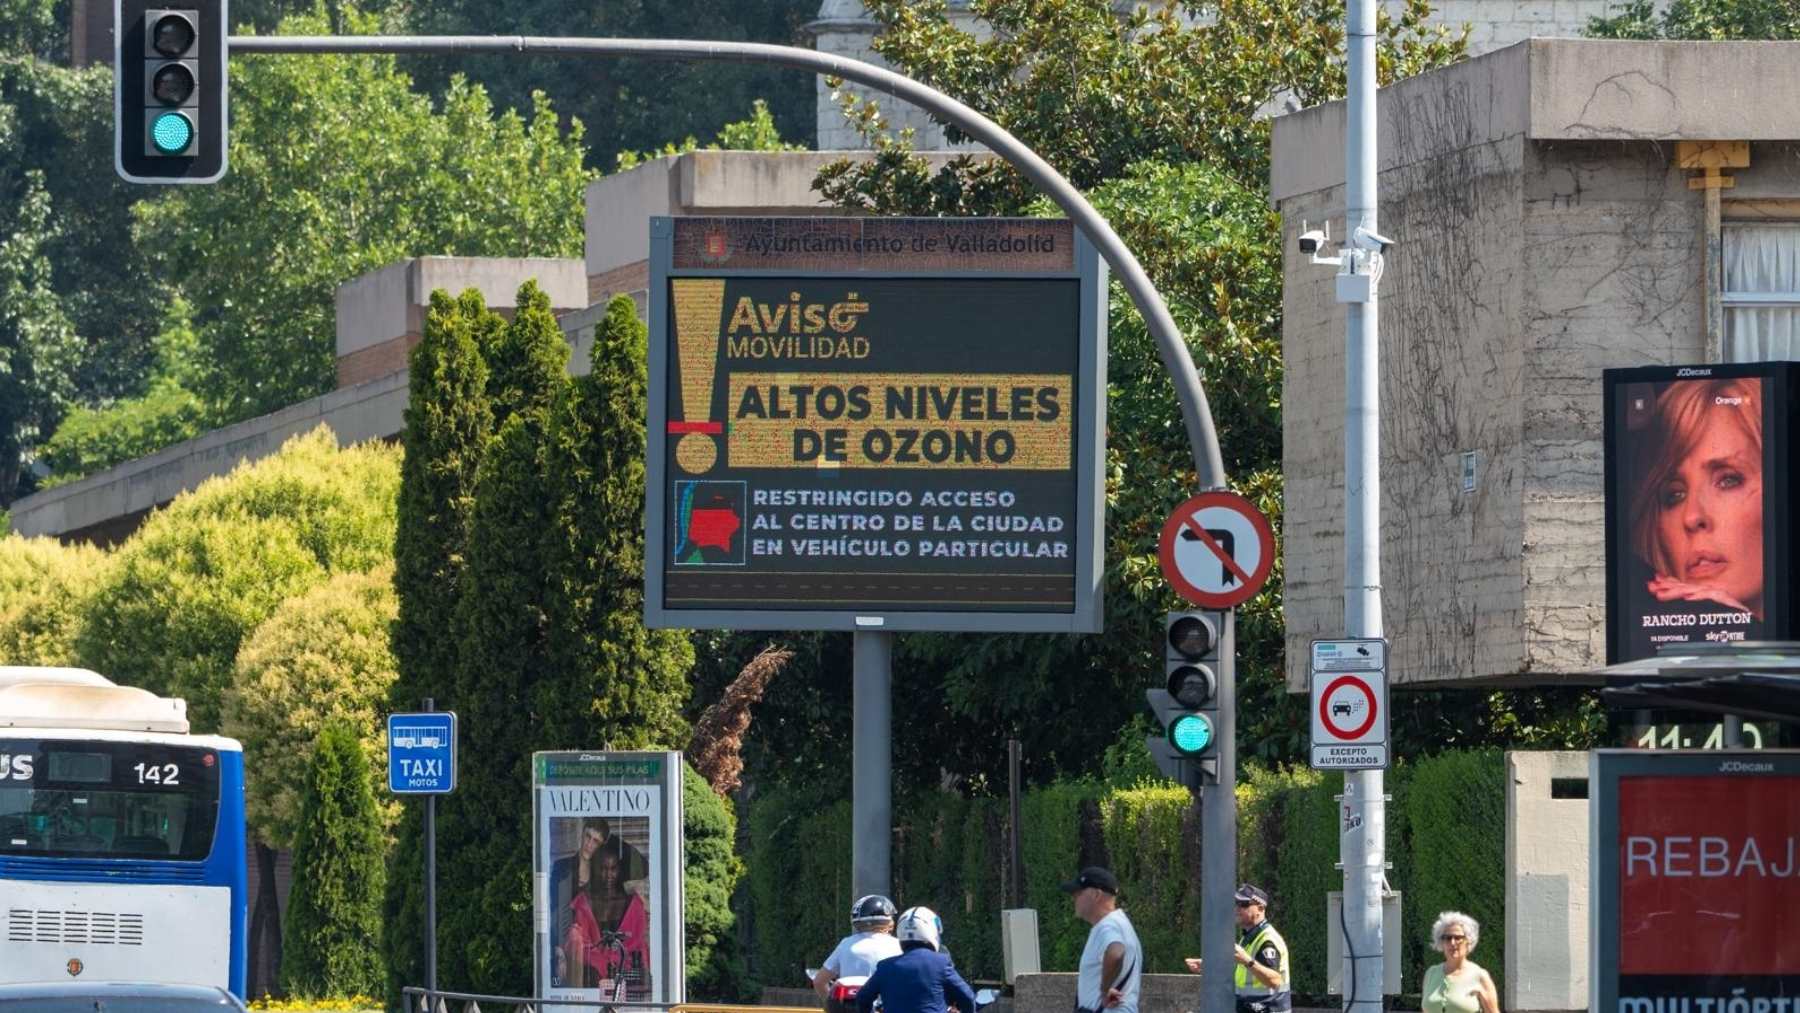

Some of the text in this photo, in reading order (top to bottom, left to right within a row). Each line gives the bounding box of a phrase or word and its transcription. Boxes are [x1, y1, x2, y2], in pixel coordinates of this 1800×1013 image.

[746, 232, 1055, 256] Ayuntamiento de Valladolid
[727, 291, 870, 334] Aviso
[727, 336, 870, 359] MOVILIDAD
[736, 385, 1061, 423] ALTOS NIVELES
[793, 429, 1017, 464] DE OZONO
[753, 489, 1016, 508] RESTRINGIDO ACCESO
[752, 514, 1064, 534] AL CENTRO DE LA CIUDAD
[752, 535, 1069, 559] EN VEHÍCULO PARTICULAR
[1642, 612, 1752, 628] RANCHO DUTTON
[1319, 756, 1379, 765] AUTORIZADOS
[1330, 748, 1368, 756] EXCEPTO
[134, 763, 179, 785] 142
[400, 759, 443, 777] TAXI
[1719, 761, 1775, 773] JCDecaux
[408, 778, 439, 788] MOTOS
[550, 789, 650, 812] VALENTINO
[1627, 836, 1800, 877] REBAJ
